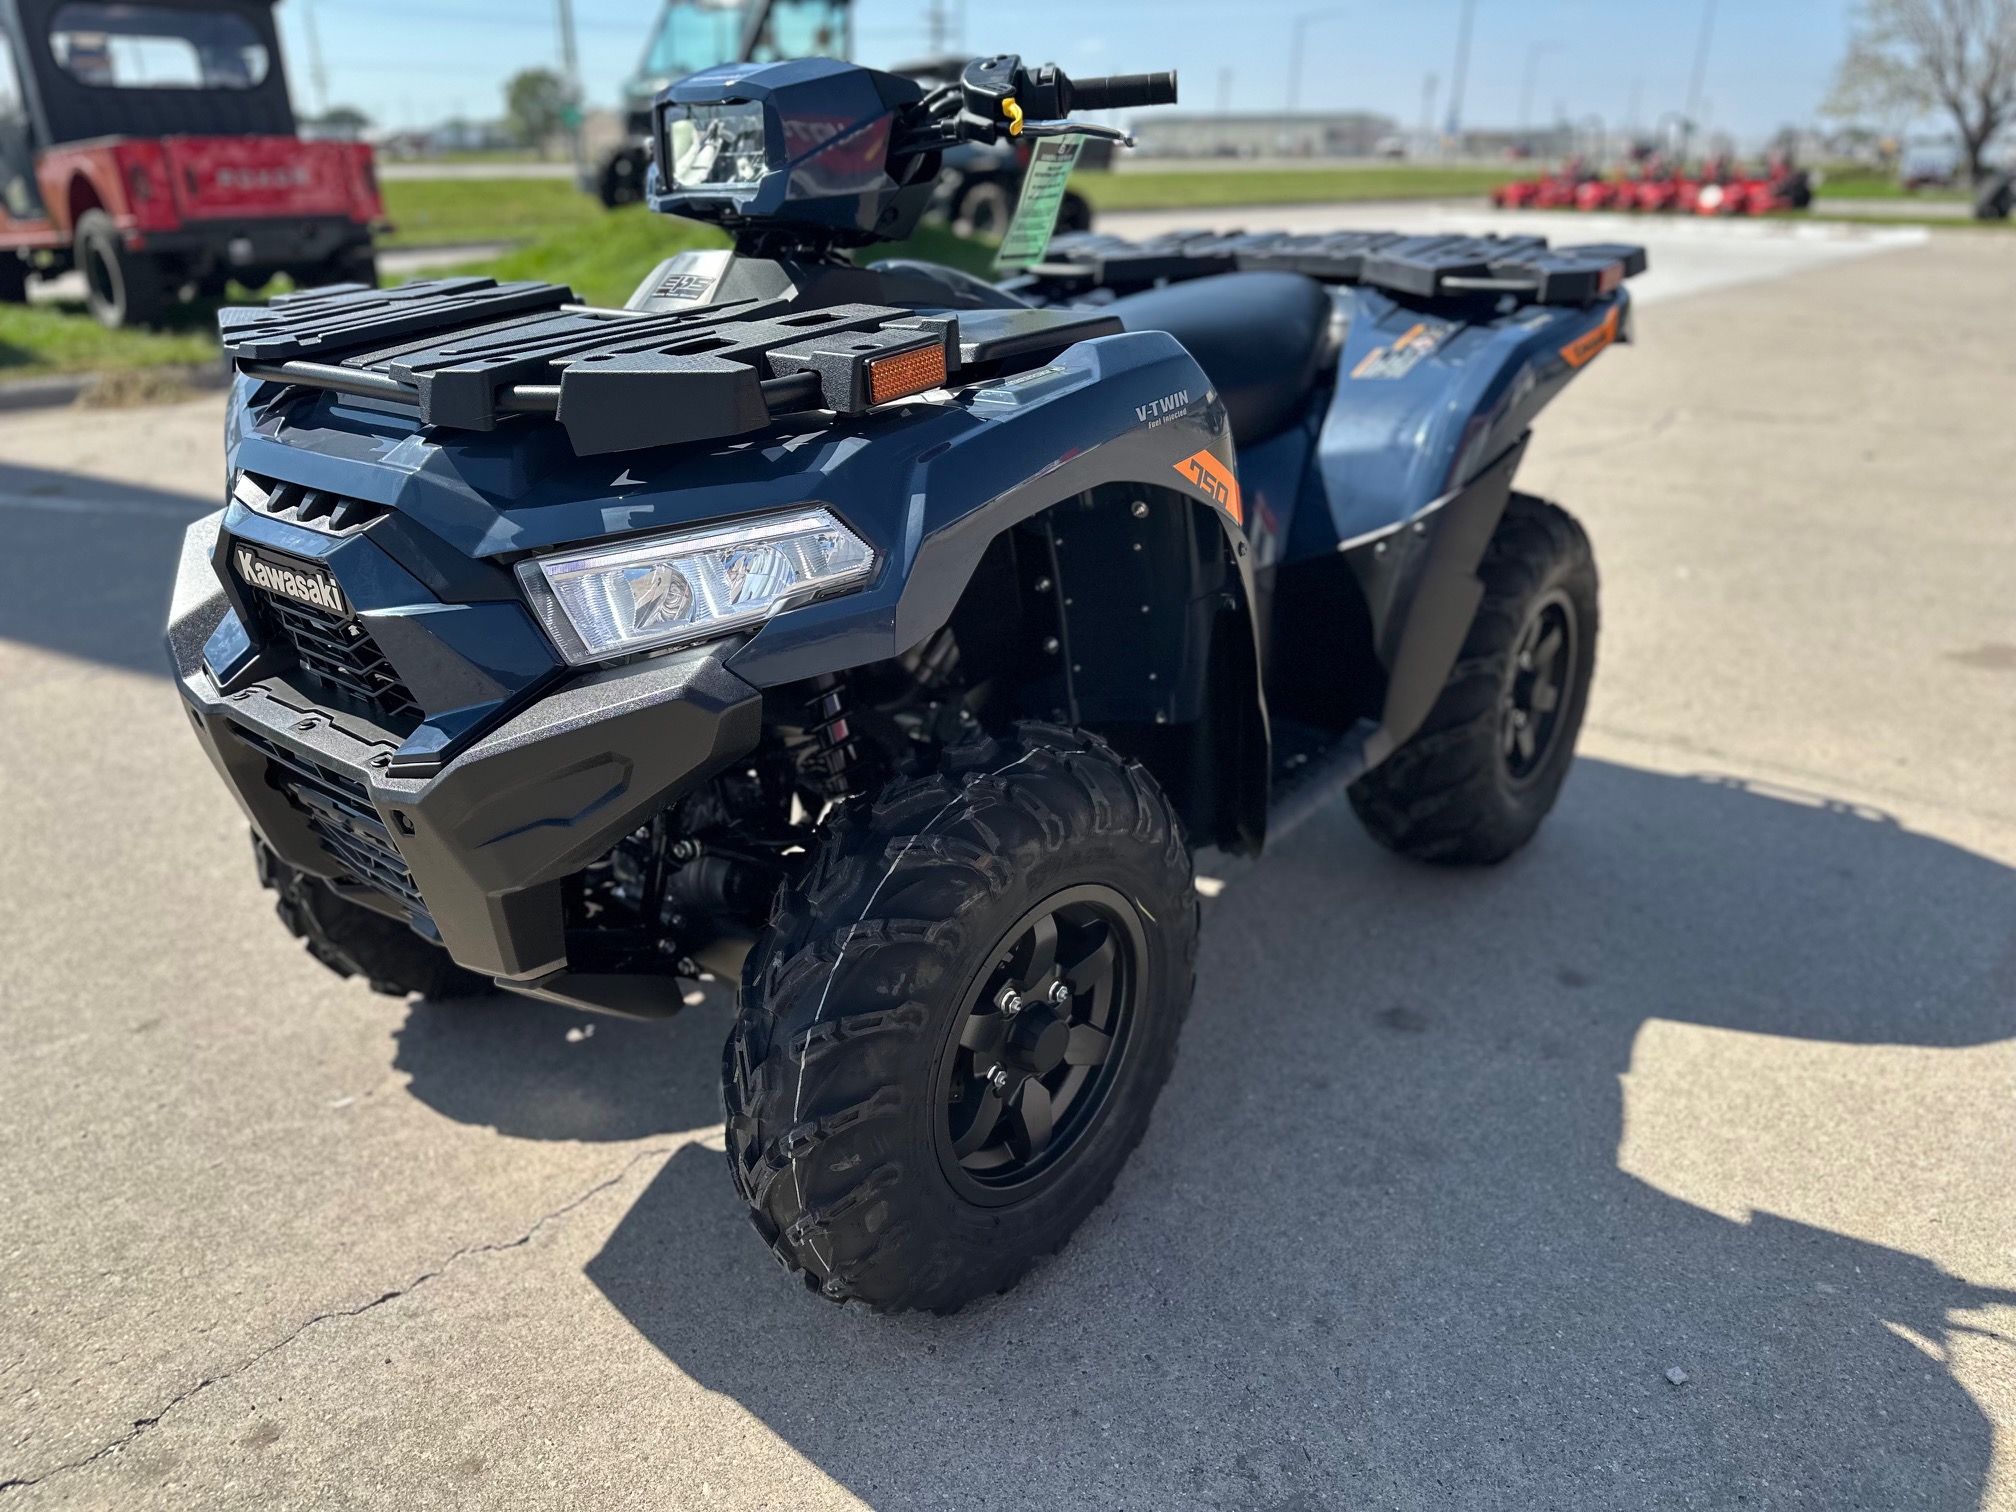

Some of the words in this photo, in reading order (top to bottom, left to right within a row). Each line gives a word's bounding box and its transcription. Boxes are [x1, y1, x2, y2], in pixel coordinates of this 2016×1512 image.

[656, 275, 713, 293] EPS
[1135, 389, 1189, 422] V-TWIN
[1148, 417, 1162, 429] Fuel
[1163, 407, 1188, 423] Injected
[1189, 458, 1229, 509] 750
[237, 549, 343, 612] Kawasaki
